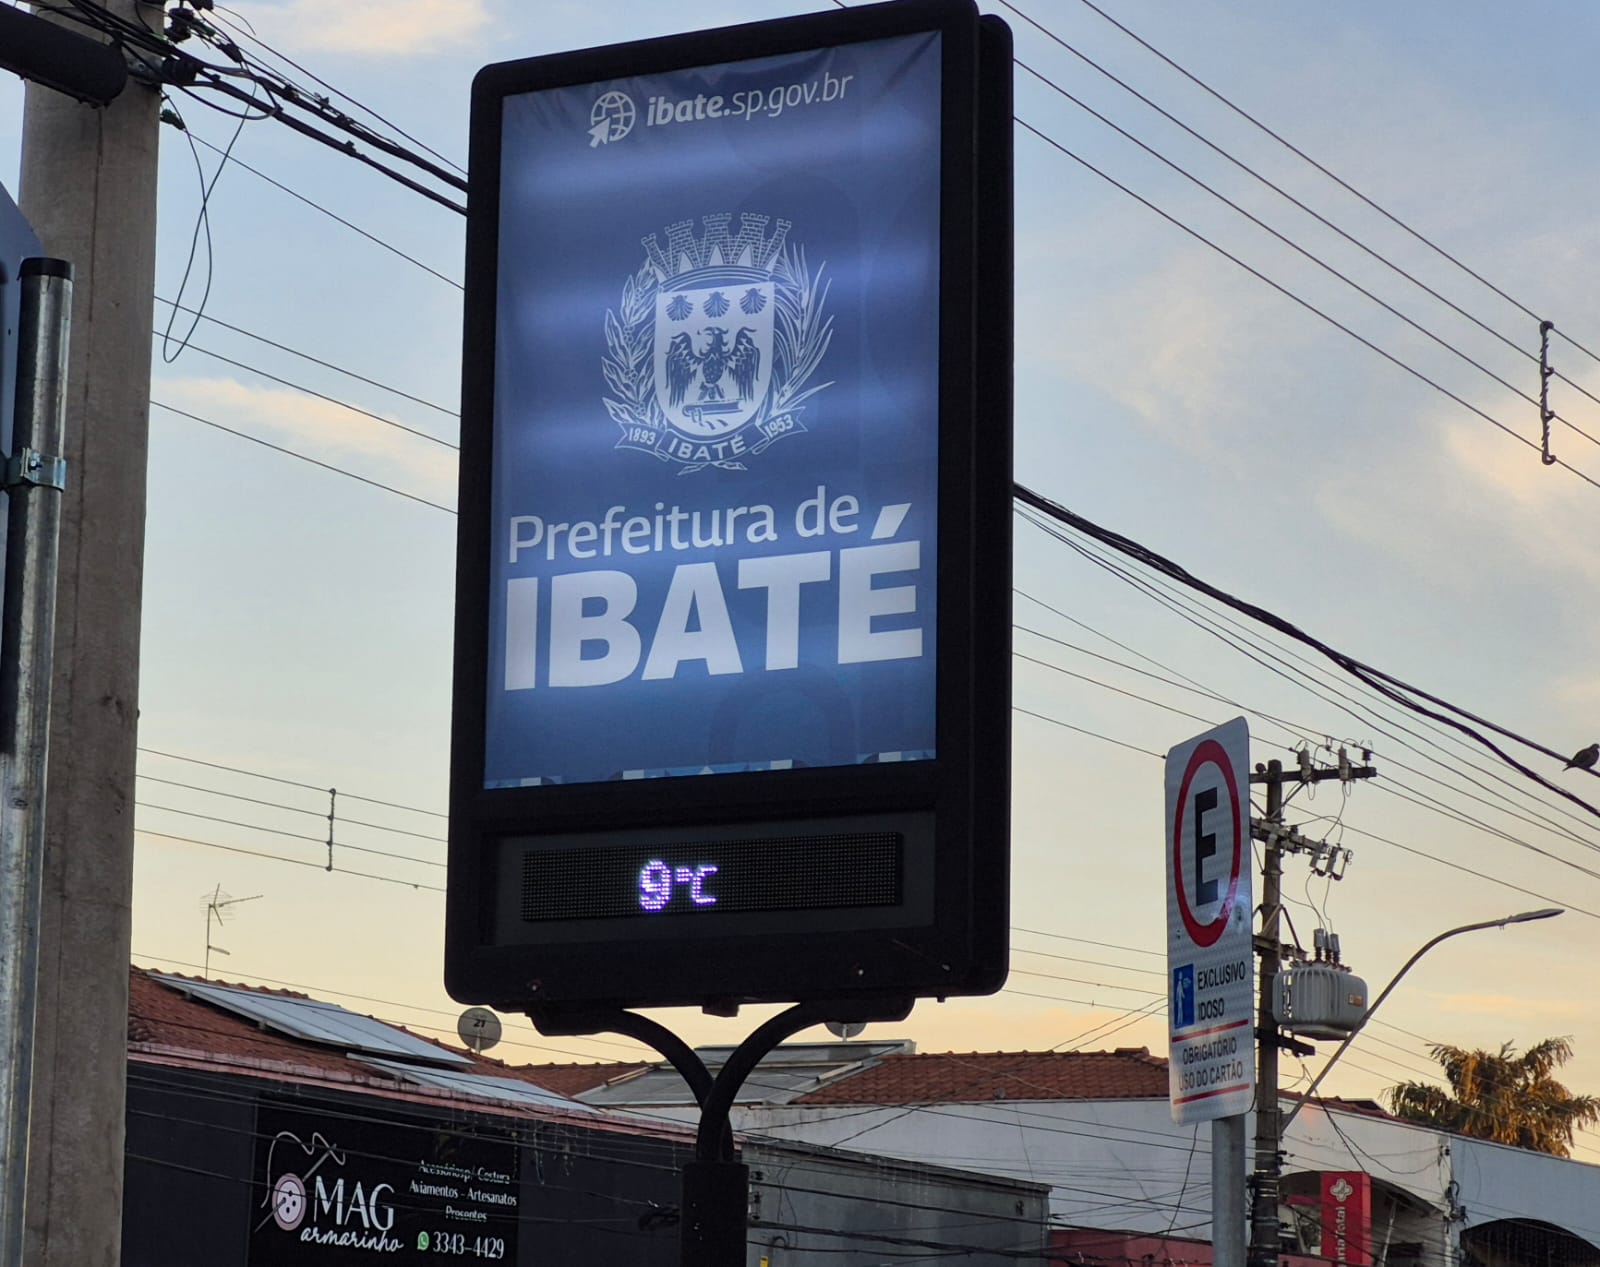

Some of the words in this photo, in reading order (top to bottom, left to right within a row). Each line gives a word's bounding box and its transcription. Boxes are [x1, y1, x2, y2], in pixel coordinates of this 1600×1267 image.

[647, 72, 854, 126] ibate.sp.gov.br
[628, 427, 656, 445] 1893
[764, 415, 794, 439] 1953
[668, 434, 746, 460] IBATÉ
[509, 502, 777, 563] Prefeitura
[795, 485, 859, 538] de
[504, 503, 923, 691] IBATÉ
[1195, 787, 1218, 906] E
[640, 859, 718, 912] 9°C
[1197, 961, 1246, 990] EXCLUSIVO
[1198, 998, 1225, 1021] IDOSO
[1183, 1035, 1237, 1065] OBRIGATÓRIO
[1179, 1072, 1195, 1091] USO
[1197, 1069, 1208, 1087] DO
[1210, 1058, 1243, 1085] CARTÃO
[477, 1167, 510, 1184] Costura
[313, 1175, 395, 1231] MAG
[409, 1179, 458, 1199] Aviamentos
[466, 1187, 517, 1206] Artesanatos
[300, 1226, 404, 1252] armarinho
[432, 1231, 504, 1259] 3343-4429
